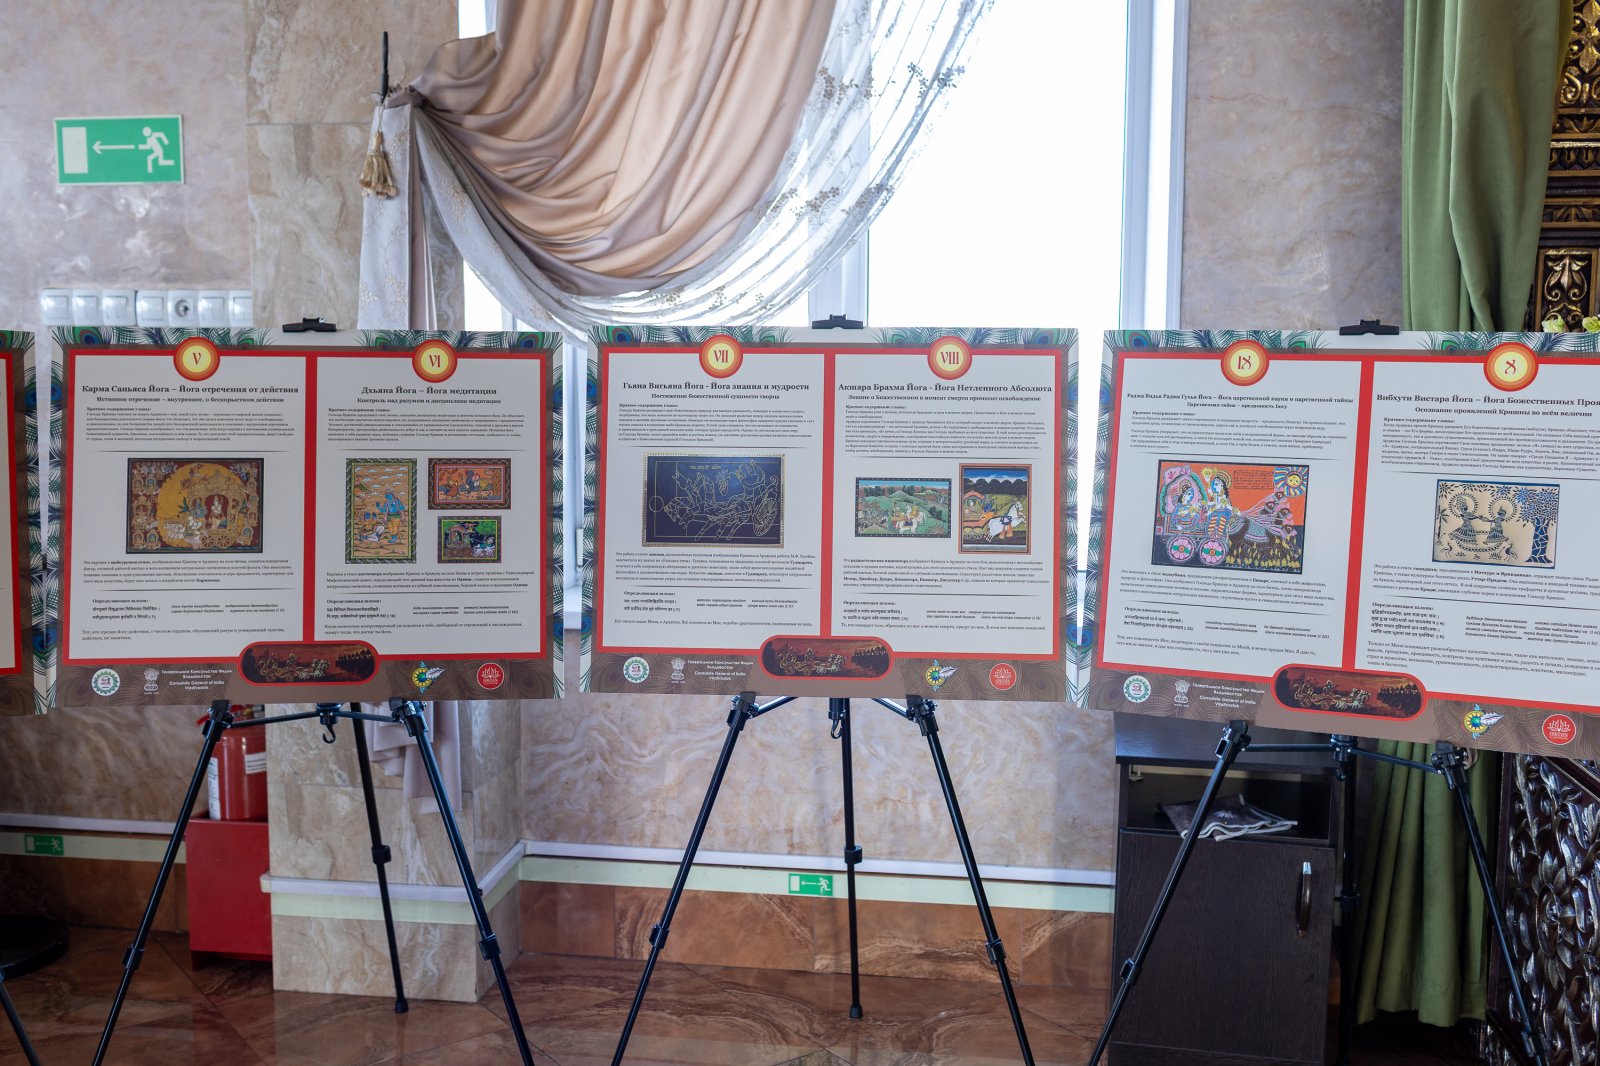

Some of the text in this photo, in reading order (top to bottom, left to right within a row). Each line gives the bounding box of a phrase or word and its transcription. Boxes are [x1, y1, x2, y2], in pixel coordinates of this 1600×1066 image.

[193, 353, 201, 365] V
[429, 355, 440, 367] VI
[714, 350, 728, 363] VII
[940, 352, 959, 364] VIII
[1237, 356, 1252, 370] IX
[82, 385, 110, 394] Карма
[361, 386, 394, 395] Дхьяна
[838, 384, 872, 392] Акшара
[873, 384, 905, 392] Брахма
[1377, 394, 1412, 403] Вибхути
[1414, 395, 1450, 404] Вистара
[1452, 394, 1473, 403] Йога
[1483, 395, 1505, 403] Йога
